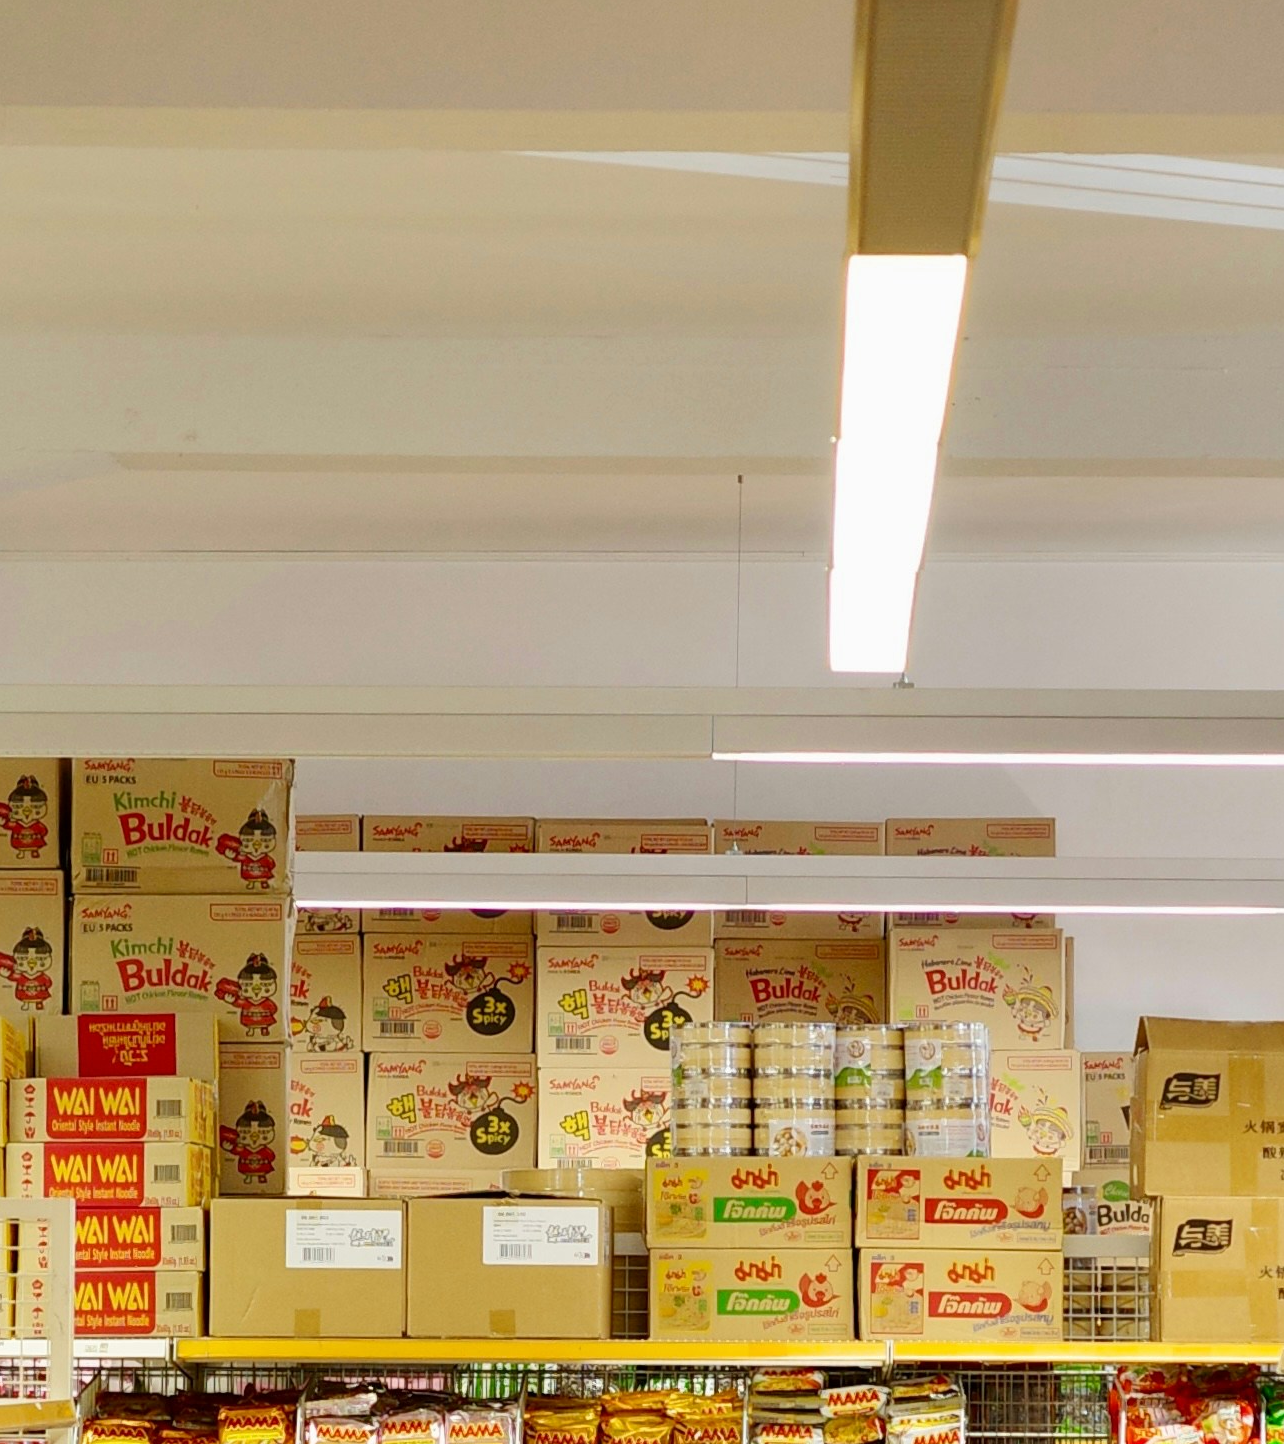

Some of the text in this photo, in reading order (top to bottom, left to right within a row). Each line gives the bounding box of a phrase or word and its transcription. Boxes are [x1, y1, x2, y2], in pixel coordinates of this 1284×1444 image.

[85, 759, 135, 771] SAMYANG
[85, 776, 136, 784] EU 5 PACKS
[113, 791, 177, 811] Kimchi
[119, 812, 214, 847] Buldak
[373, 823, 422, 836] SAMYANG
[895, 825, 934, 837] SAMYANG
[549, 832, 600, 847] SAMYANG
[81, 904, 132, 919] SAMYANG
[83, 923, 132, 932] EU 5 PACKS
[110, 937, 174, 959] Kimchi
[374, 941, 423, 955] SAMYANG
[898, 935, 939, 949] SAMYANG
[724, 945, 763, 957] SAMYANG
[548, 954, 599, 969] SAMYANG
[921, 958, 972, 969] Habanero Lime
[116, 959, 212, 993] Buldak
[925, 969, 999, 995] Buldak
[383, 974, 413, 1004] 핵
[749, 979, 822, 1004] Buldak
[484, 997, 507, 1011] 3x
[559, 989, 589, 1019] 핵
[473, 1009, 507, 1025] Spicy
[377, 1060, 426, 1074] SAMYANG
[1084, 1058, 1123, 1070] SAMYANG
[549, 1075, 600, 1090] SAMYANG
[1085, 1073, 1098, 1082] EU
[1107, 1072, 1126, 1081] PACKS
[53, 1087, 140, 1116] WAI WAI
[387, 1093, 416, 1123] 핵
[52, 1119, 140, 1132] Oriental Style Instant Noodle
[488, 1116, 510, 1132] 3x
[560, 1111, 590, 1141] 핵
[477, 1130, 510, 1145] Spicy
[50, 1153, 138, 1183] WAI WAI
[731, 1163, 779, 1190] มาม่า
[943, 1164, 991, 1190] มาม่า
[76, 1187, 91, 1200] Style
[93, 1187, 114, 1198] Instant
[116, 1187, 138, 1198] Noodle
[723, 1200, 787, 1219] โจ๊กคัพ
[934, 1201, 999, 1220] โจ๊กคัพ
[1097, 1203, 1149, 1227] Bulda
[113, 1215, 154, 1244] WAI
[93, 1249, 154, 1261] Style Instant Noodle
[735, 1256, 782, 1282] มาม่า
[947, 1257, 995, 1284] มาม่า
[107, 1282, 148, 1310] WAI
[726, 1292, 791, 1311] โจ๊กคัพ
[937, 1295, 1002, 1314] โจ๊กคัพ
[86, 1315, 149, 1328] Style Instant Noodle
[828, 1389, 881, 1406] MAMA
[226, 1416, 281, 1429] MAMA
[449, 1422, 502, 1438] MAMA
[317, 1425, 368, 1441] MAMA
